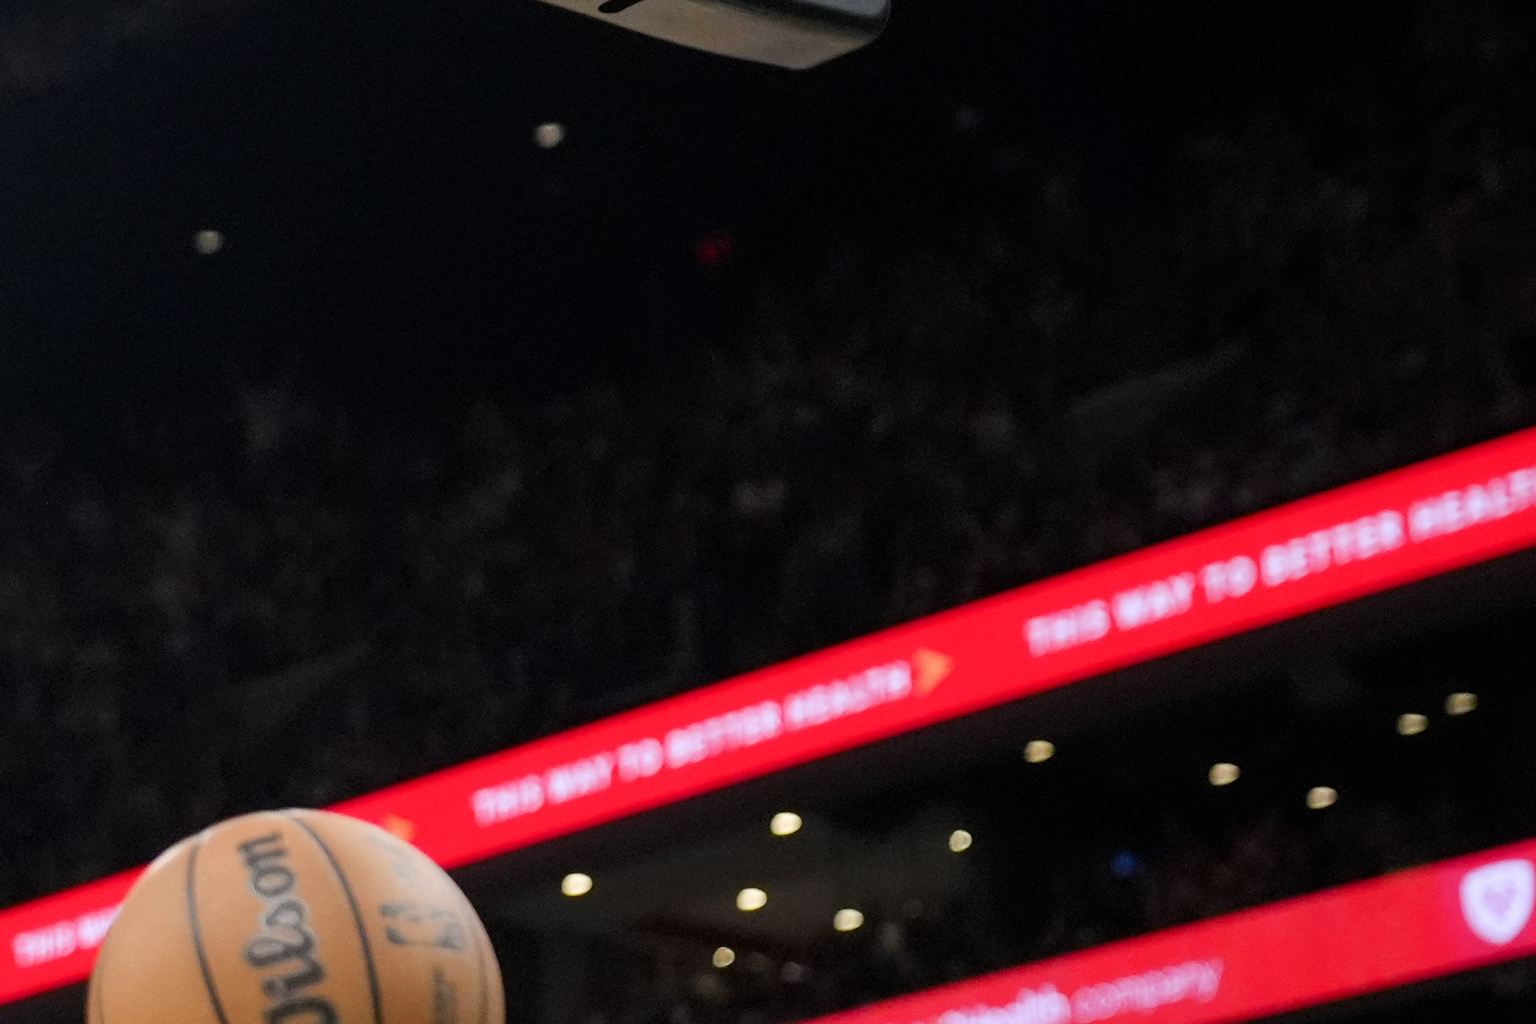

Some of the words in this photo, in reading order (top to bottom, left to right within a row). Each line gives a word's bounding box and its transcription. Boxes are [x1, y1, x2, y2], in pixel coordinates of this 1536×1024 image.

[1024, 600, 1112, 657] THIS
[1113, 572, 1195, 632] WAY
[1199, 555, 1258, 604] TO
[1260, 509, 1405, 586] BETTER
[1407, 467, 1536, 542] HEALT
[470, 775, 544, 828] THIS
[545, 751, 615, 804] WAY
[617, 737, 664, 782] TO
[664, 700, 782, 770] BETTER
[782, 659, 913, 731] HEALTH
[1071, 956, 1224, 1024] company
